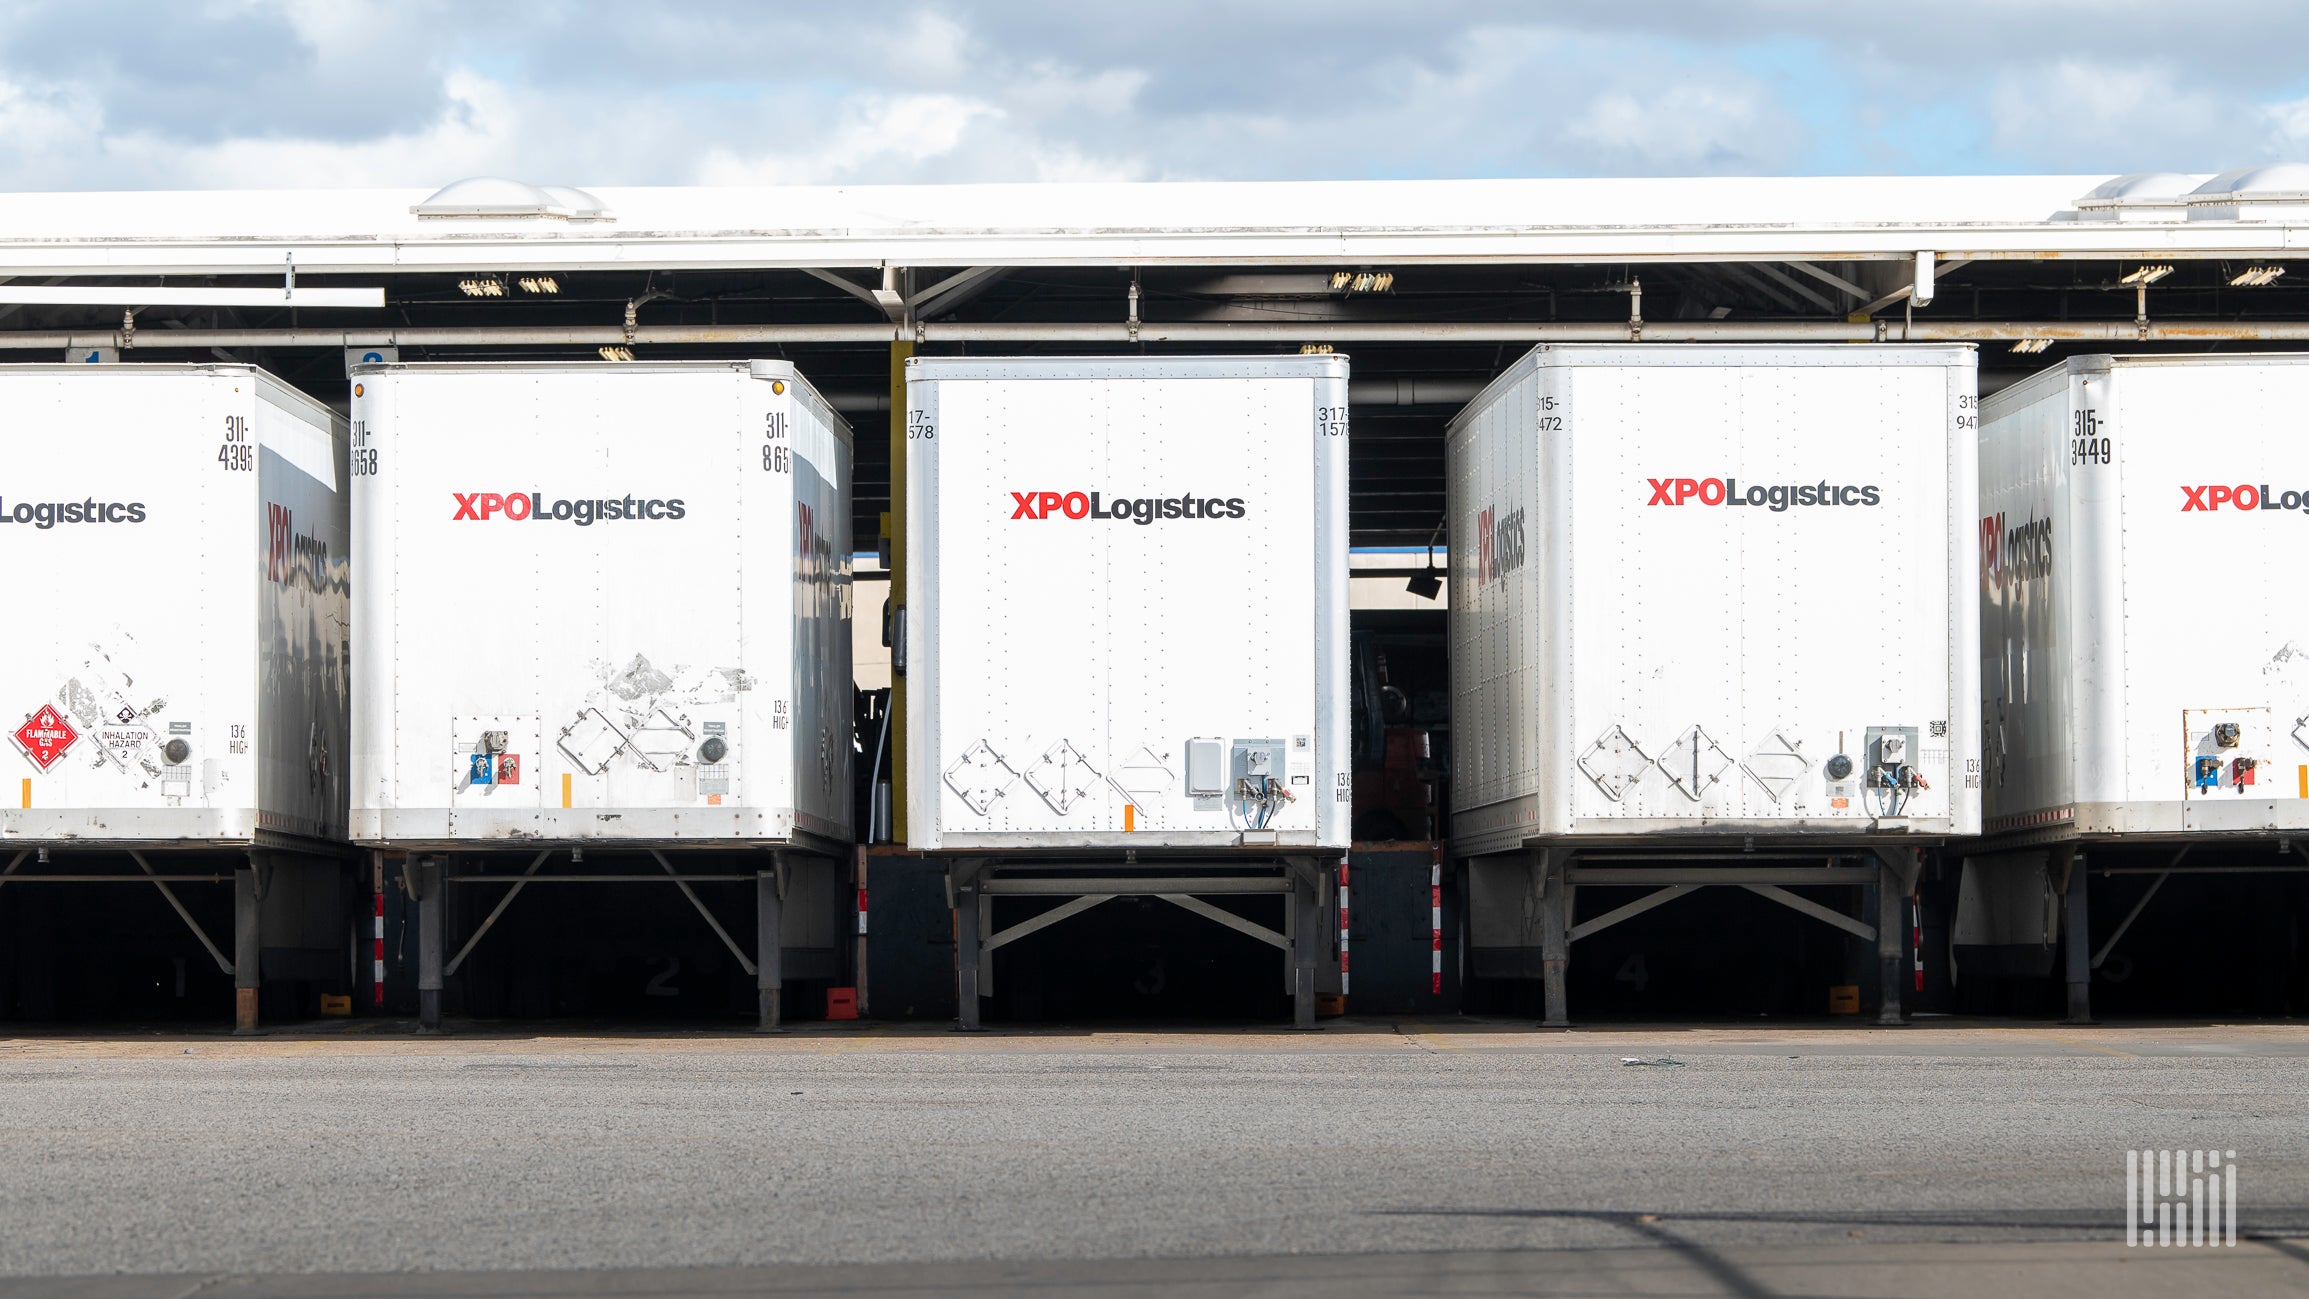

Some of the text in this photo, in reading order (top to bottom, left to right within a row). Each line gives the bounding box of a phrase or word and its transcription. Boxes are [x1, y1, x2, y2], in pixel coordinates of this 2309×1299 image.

[1319, 422, 1349, 437] 157
[2074, 409, 2104, 437] 315-
[218, 444, 253, 472] 4395
[762, 444, 791, 474] 865
[2071, 438, 2111, 466] 3449
[1010, 491, 1246, 525] XPOLogistics
[1646, 477, 1881, 512] XPOLogistics
[452, 492, 686, 526] XPOLogistics
[102, 731, 149, 740] INHALATION
[108, 740, 142, 748] HAZARD
[122, 750, 128, 759] 2
